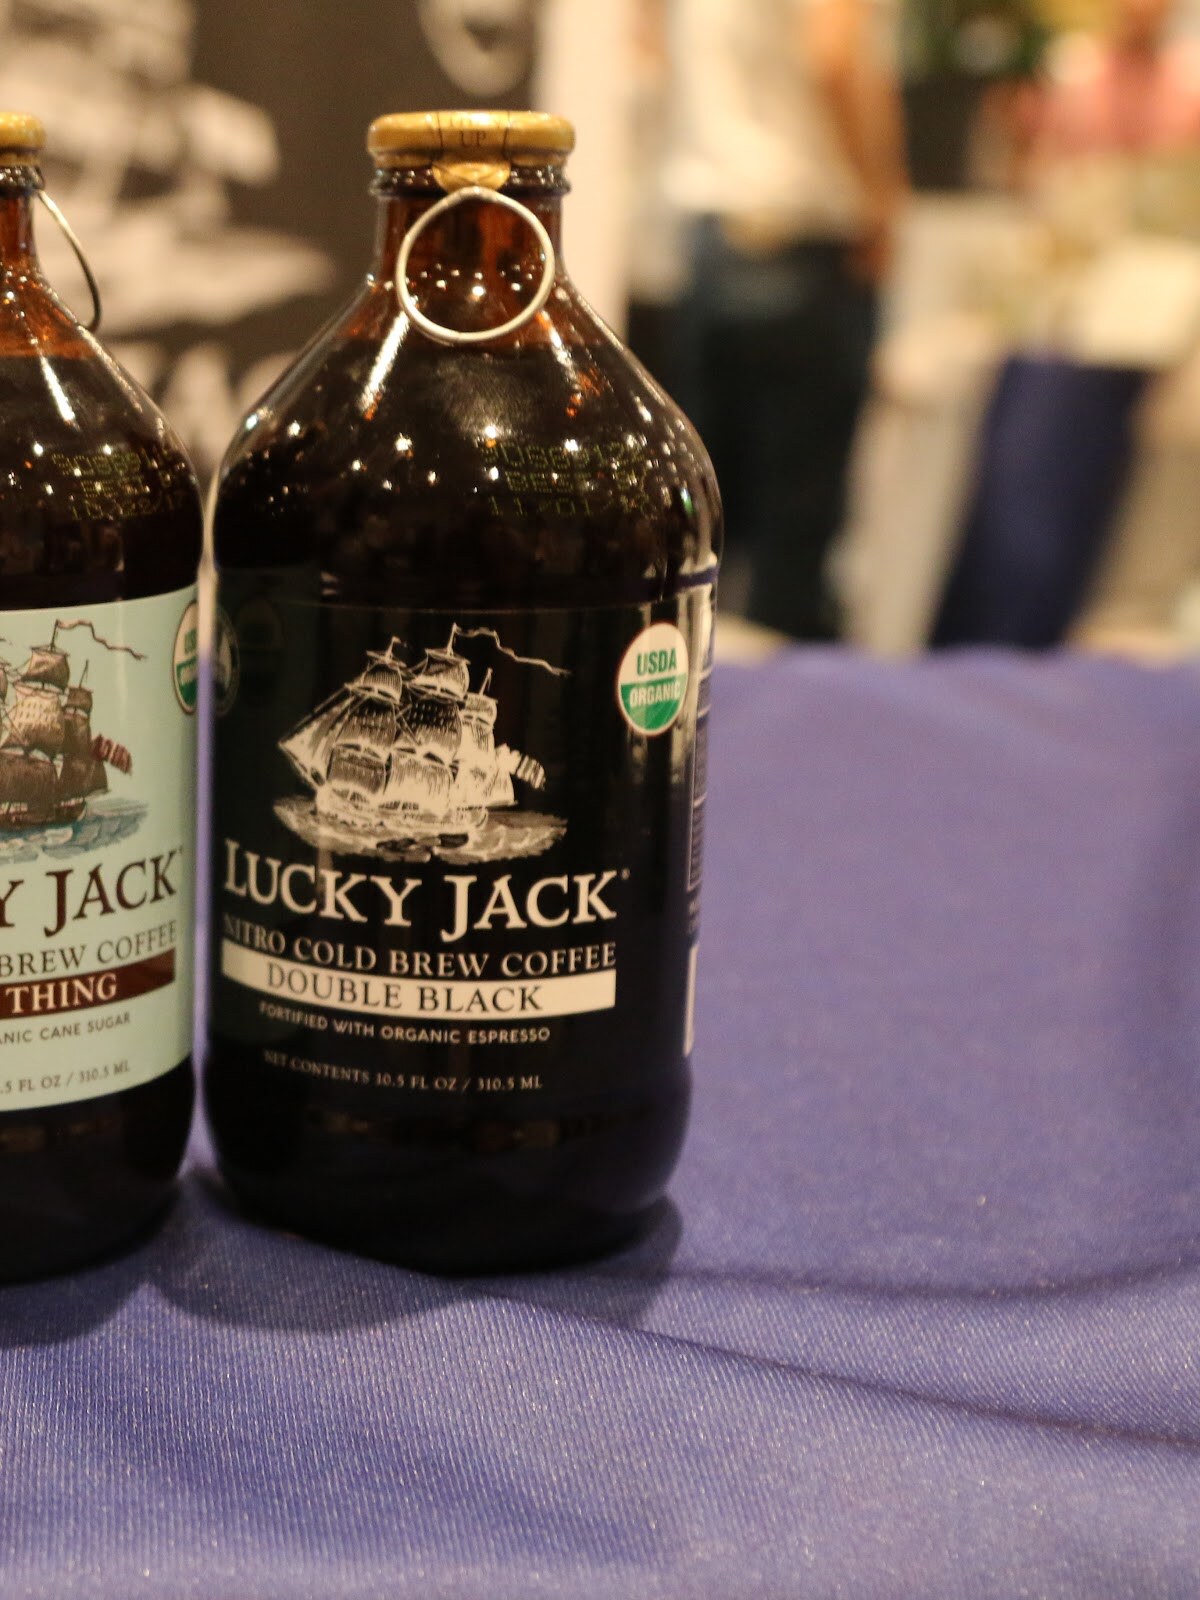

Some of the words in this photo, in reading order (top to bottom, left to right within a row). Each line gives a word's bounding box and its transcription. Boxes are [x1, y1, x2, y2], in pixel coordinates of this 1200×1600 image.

[459, 130, 486, 149] UP
[637, 647, 677, 676] USDA
[629, 681, 681, 709] ORGANIC
[43, 849, 177, 937] JACK
[223, 837, 423, 927] LUCKY
[440, 870, 618, 944] JACK
[97, 920, 177, 965] COFFEE
[223, 913, 286, 955] NITRO
[293, 936, 377, 971] COLD
[389, 949, 490, 978] BREW
[501, 941, 617, 977] COFFEE
[4, 973, 118, 1015] THING
[267, 962, 402, 1009] DOUBLE
[417, 985, 543, 1014] BLACK
[39, 1024, 82, 1041] CANE
[87, 1012, 132, 1034] SUGAR
[259, 1000, 328, 1031] FORTIFIED
[332, 1018, 375, 1038] WITH
[381, 1025, 461, 1045] ORGANIC
[468, 1026, 550, 1044] ESPRESSO
[18, 1079, 37, 1093] FL
[41, 1074, 62, 1090] OZ
[66, 1071, 75, 1088] /
[78, 1065, 111, 1084] 310.5
[113, 1060, 131, 1076] ML
[263, 1050, 288, 1067] NET
[290, 1057, 370, 1084] CONTENTS
[376, 1072, 405, 1087] 10.5
[410, 1074, 429, 1089] FL
[434, 1077, 457, 1090] OZ
[478, 1077, 515, 1091] 310.5
[520, 1075, 543, 1090] ML
